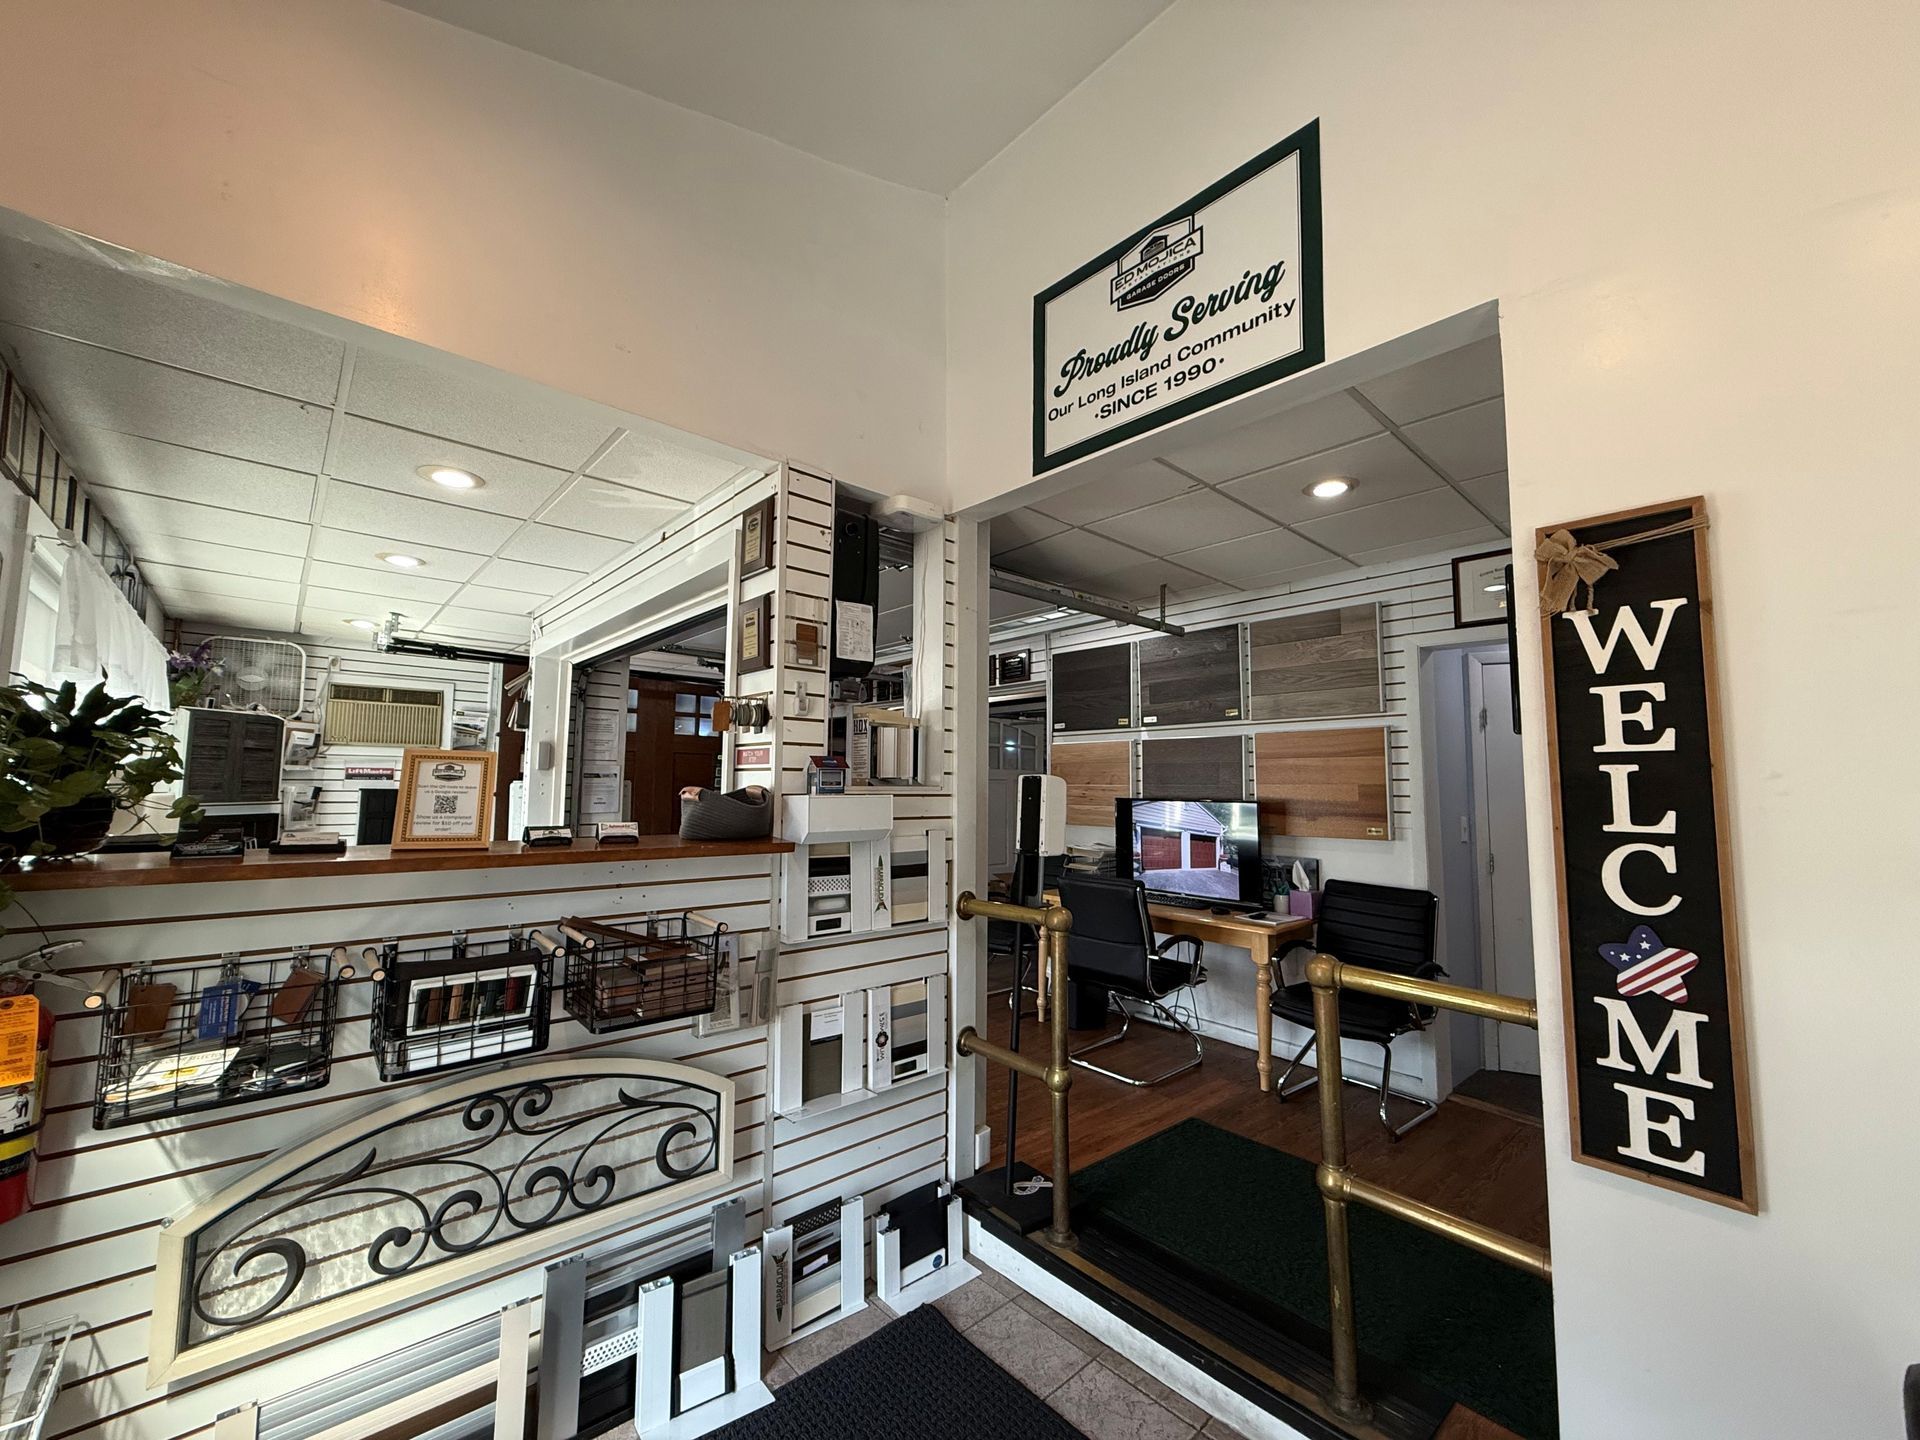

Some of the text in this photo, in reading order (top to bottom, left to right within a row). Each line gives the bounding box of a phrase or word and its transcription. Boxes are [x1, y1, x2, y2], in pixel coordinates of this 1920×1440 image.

[1114, 237, 1196, 291] ED MOJICA
[1126, 263, 1185, 300] GARAGE DOORS
[1048, 298, 1297, 422] Our Long Island Community
[1053, 260, 1286, 398] Proudly Serving
[1562, 597, 1714, 1177] WELCME
